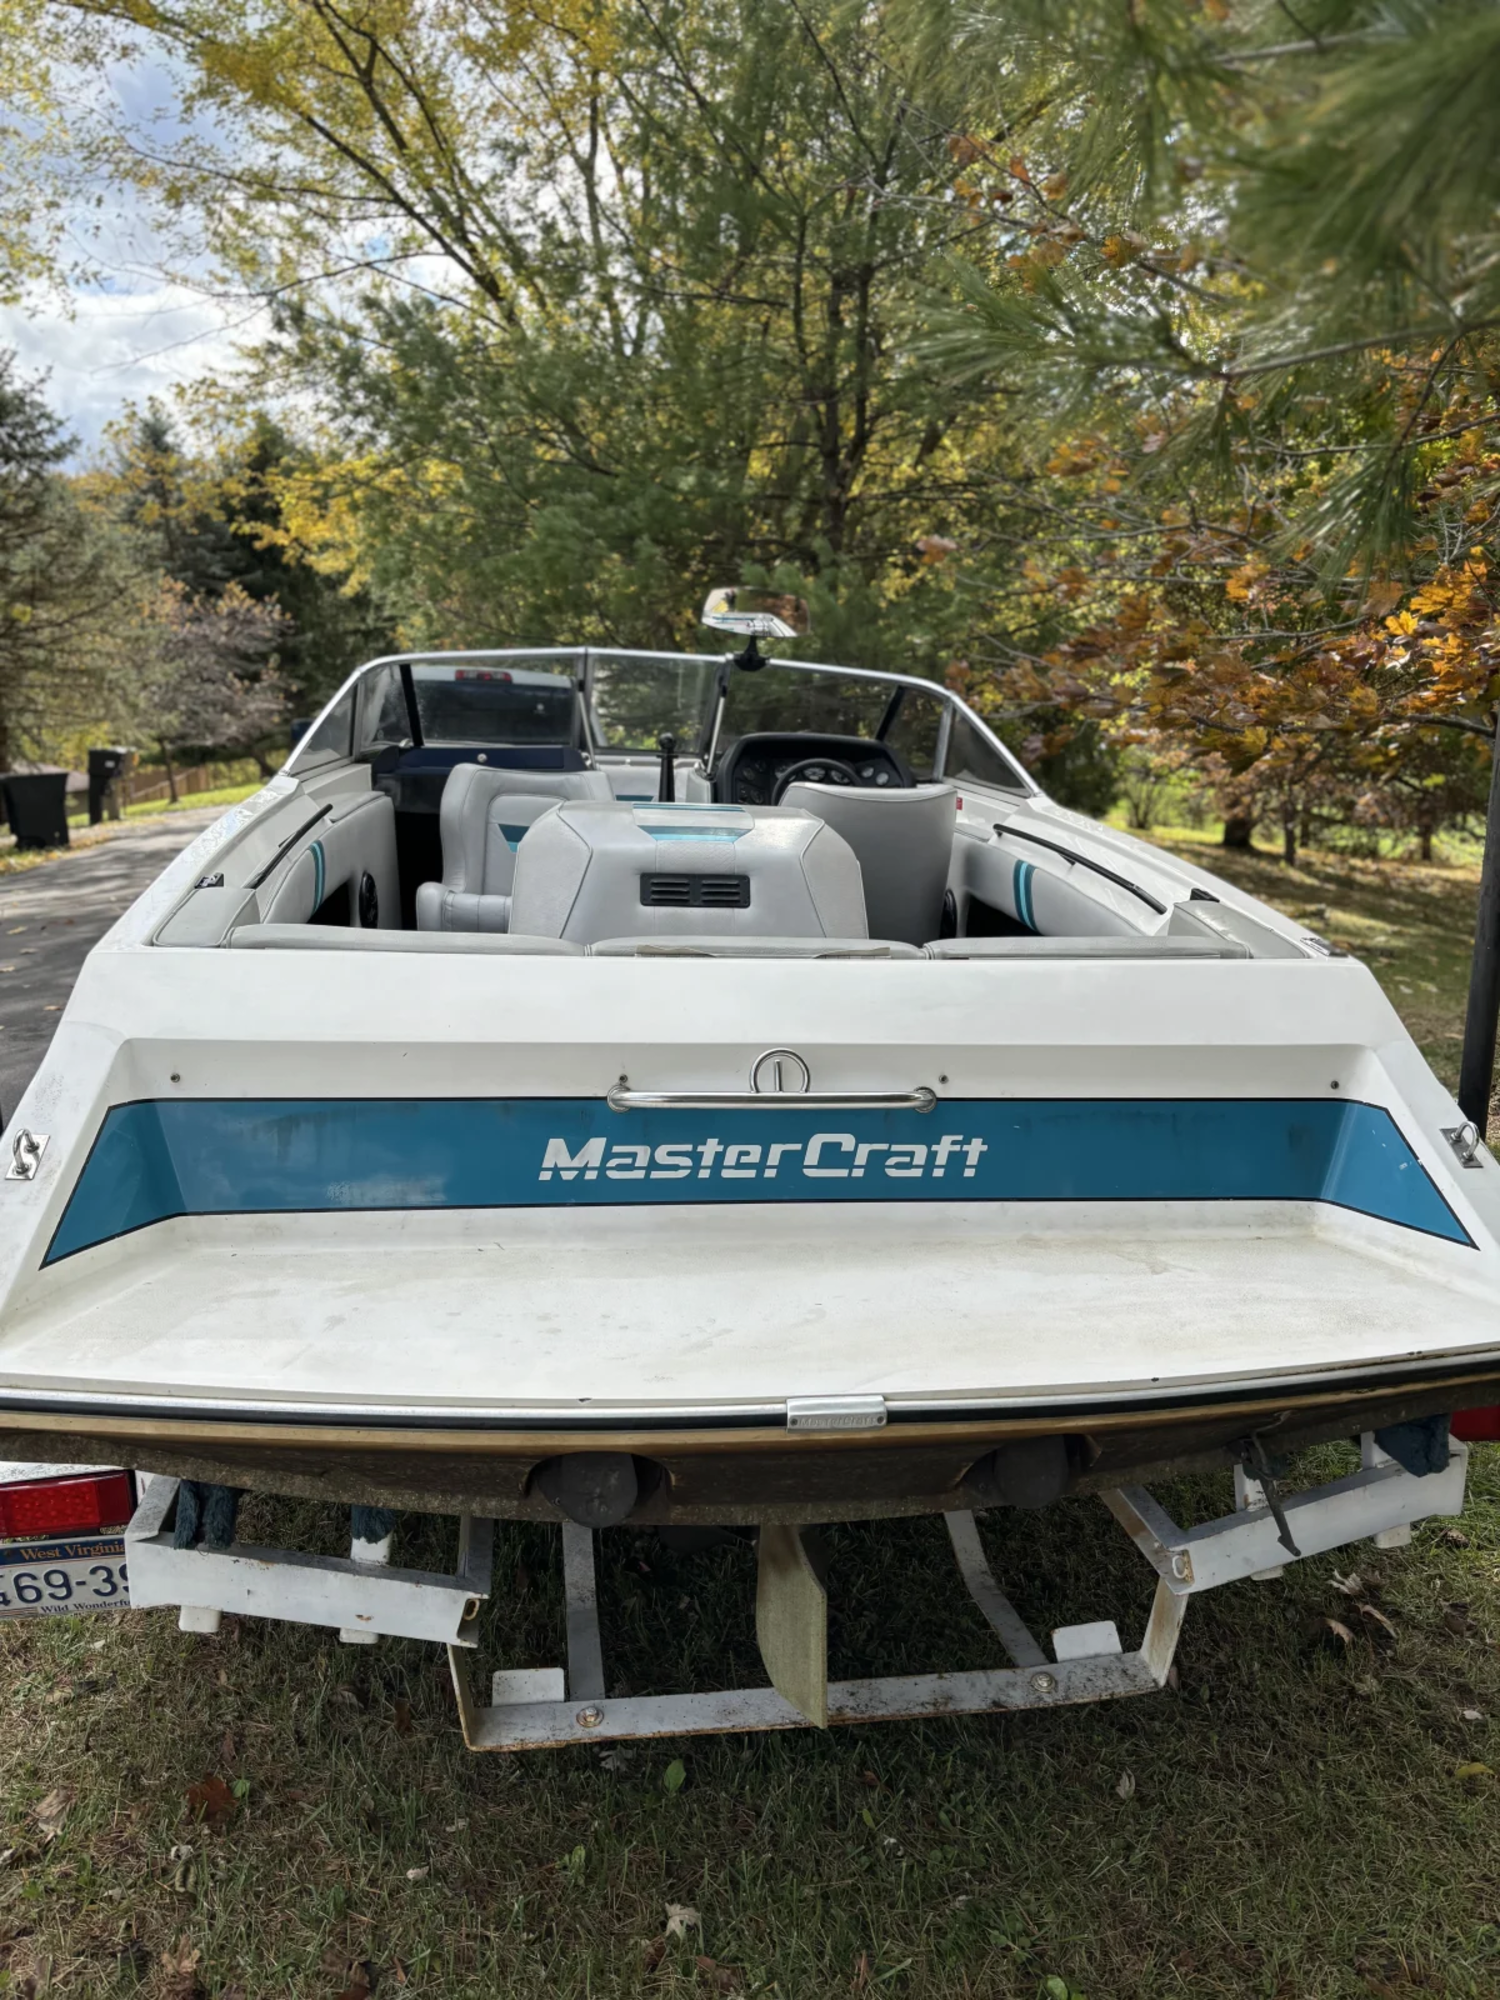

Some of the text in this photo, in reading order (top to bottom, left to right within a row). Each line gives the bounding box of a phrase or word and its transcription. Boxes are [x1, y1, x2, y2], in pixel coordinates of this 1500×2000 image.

[538, 1133, 988, 1180] MasterCraft
[20, 1547, 61, 1560] West
[41, 1599, 130, 1614] Wild Wonderfu
